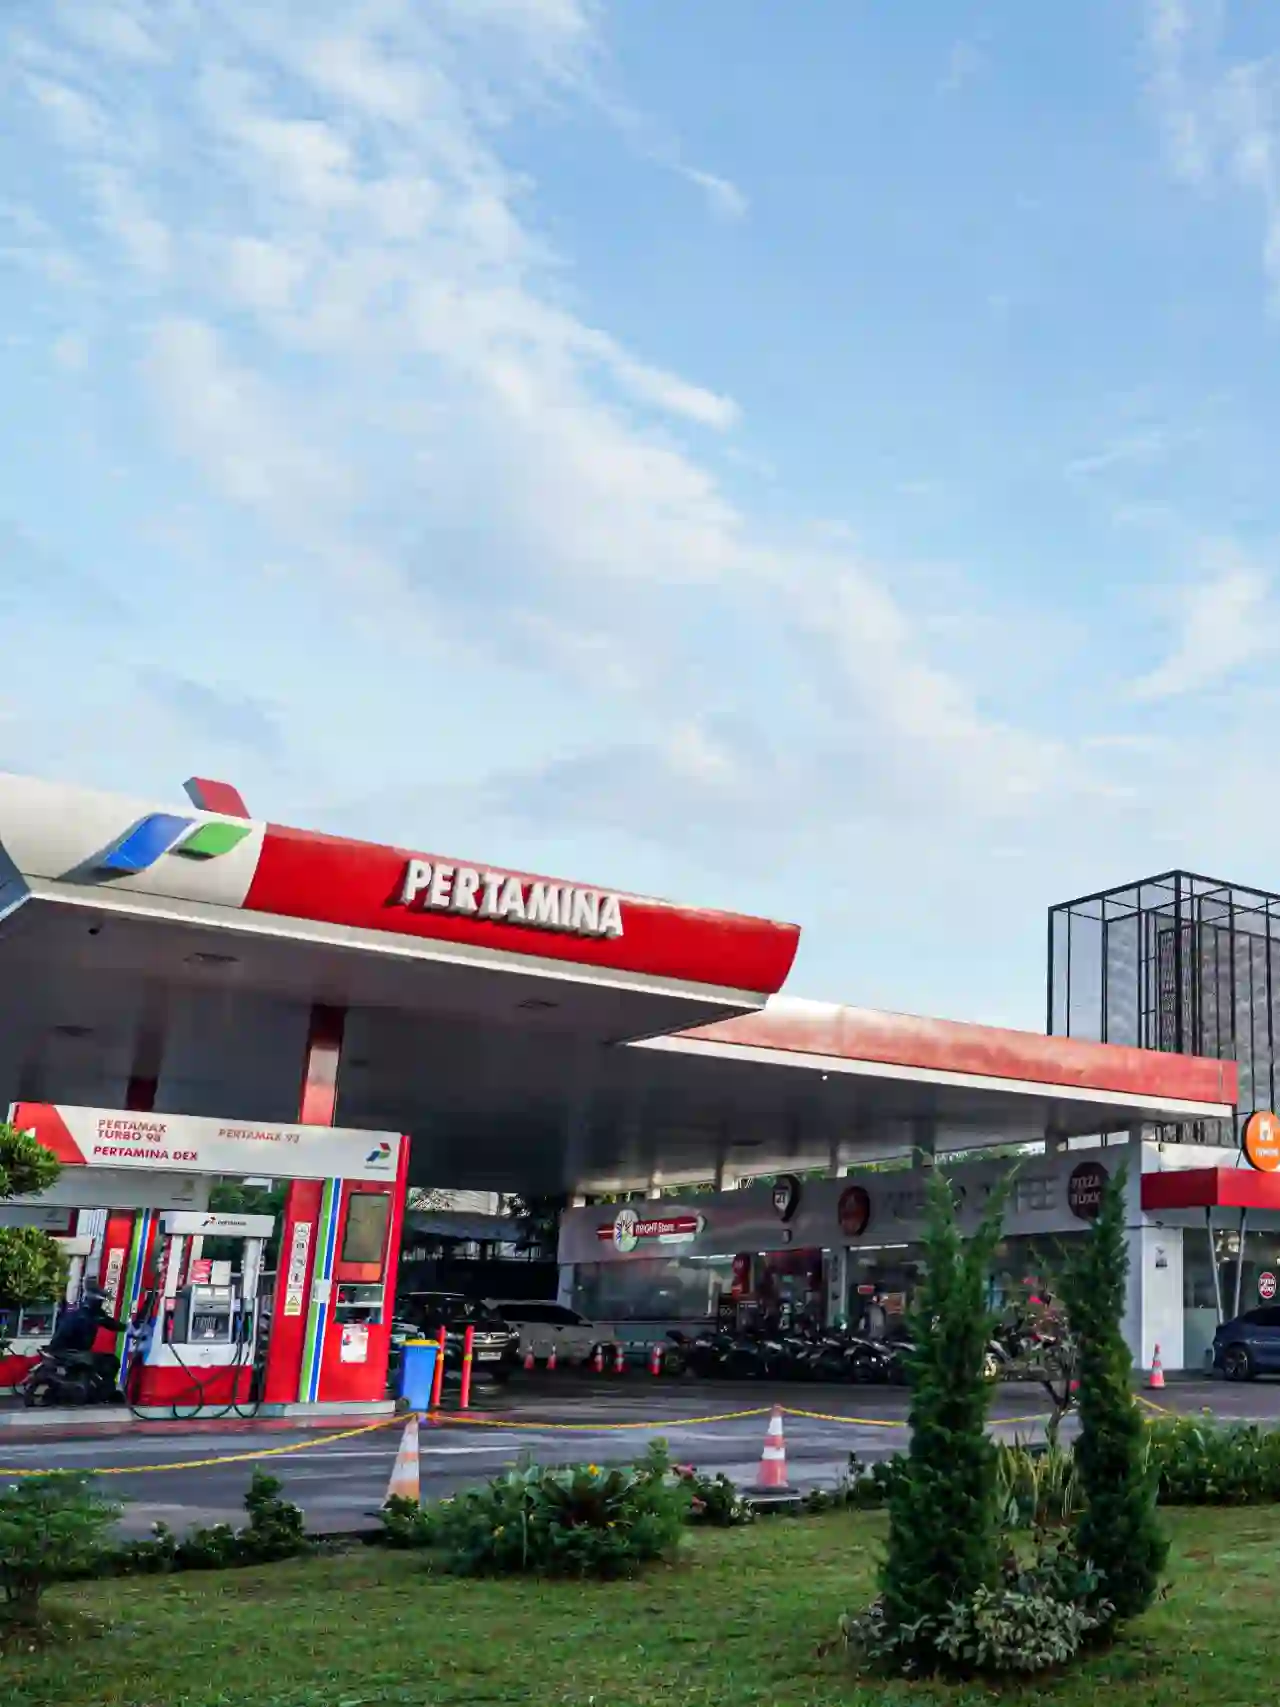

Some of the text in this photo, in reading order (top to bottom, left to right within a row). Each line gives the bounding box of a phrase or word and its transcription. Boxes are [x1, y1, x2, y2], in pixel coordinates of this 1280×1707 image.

[402, 859, 624, 938] PERTAMINA
[98, 1119, 167, 1133] PERTAMAX
[98, 1130, 141, 1141] TURBO
[218, 1128, 281, 1141] PERTAMAX
[94, 1146, 198, 1162] PERTAMINA DEX
